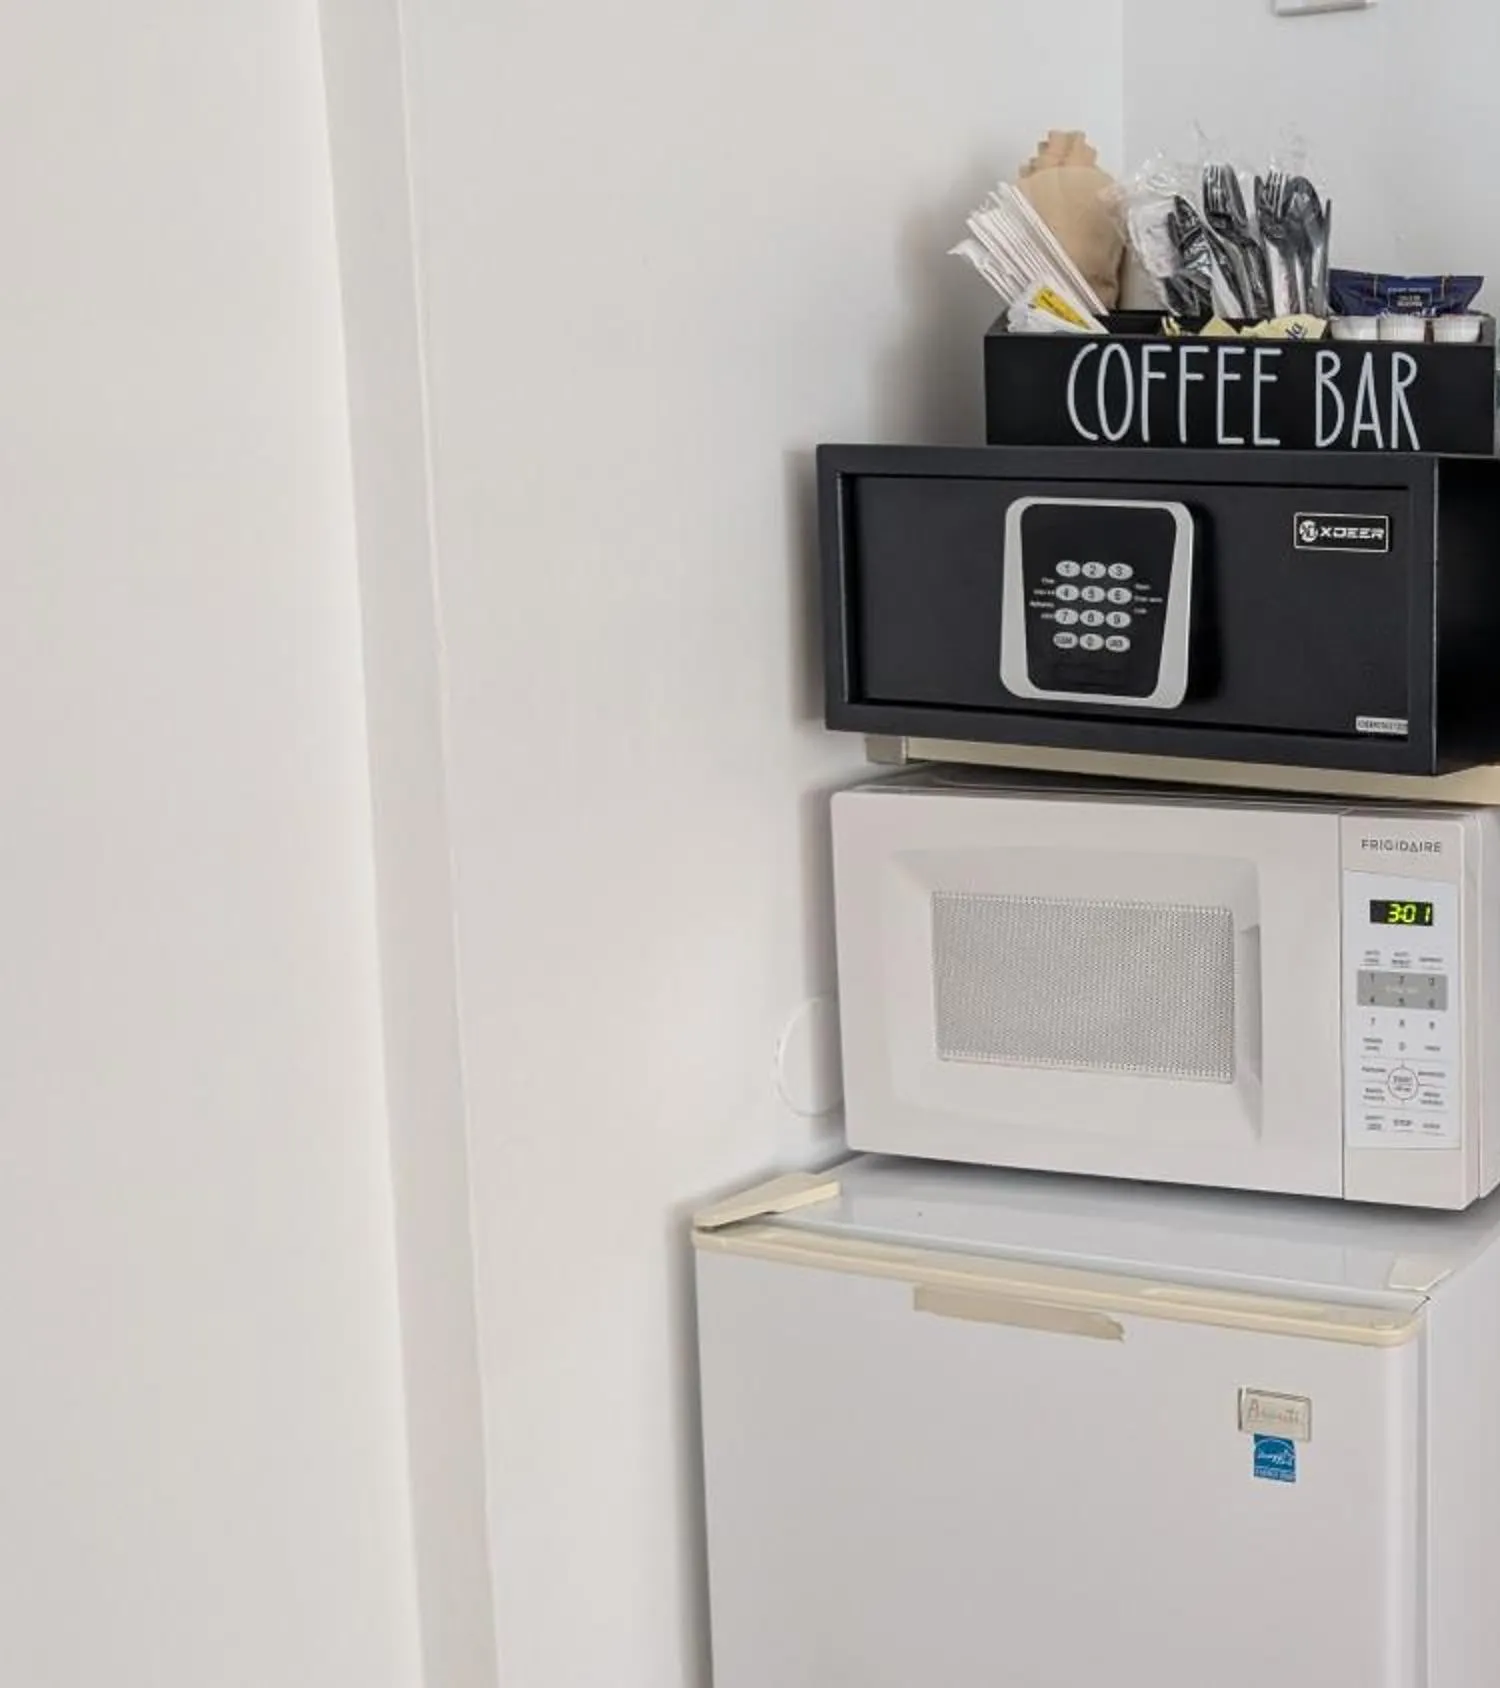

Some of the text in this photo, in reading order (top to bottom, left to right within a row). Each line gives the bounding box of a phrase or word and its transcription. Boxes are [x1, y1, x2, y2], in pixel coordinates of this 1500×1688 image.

[1066, 343, 1421, 452] COFFEE BAR
[1319, 526, 1386, 540] XDEER
[1360, 839, 1442, 853] FRIGIDAIRE
[1388, 903, 1430, 923] 3:01
